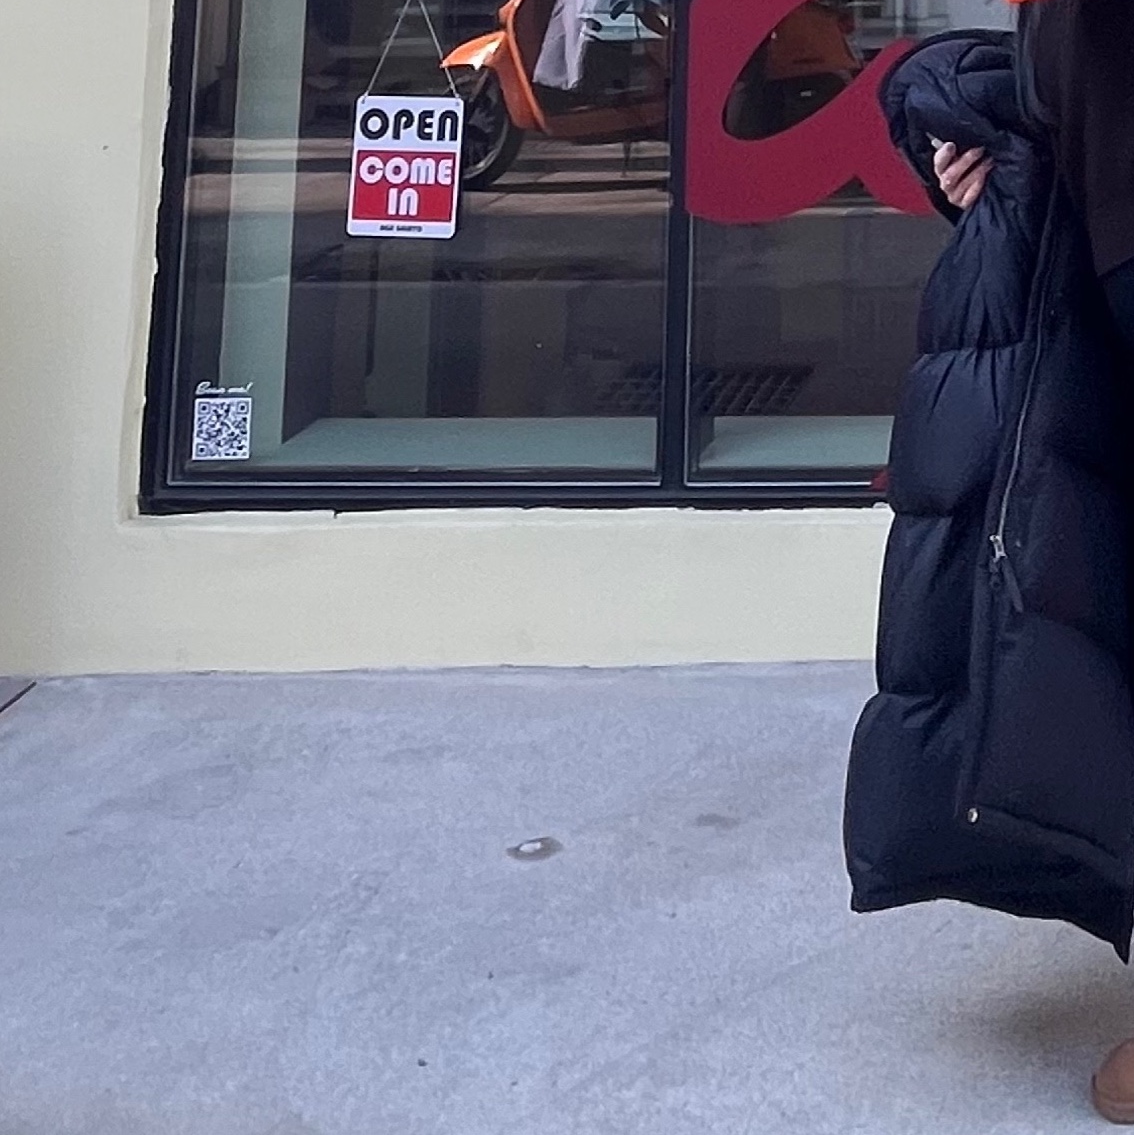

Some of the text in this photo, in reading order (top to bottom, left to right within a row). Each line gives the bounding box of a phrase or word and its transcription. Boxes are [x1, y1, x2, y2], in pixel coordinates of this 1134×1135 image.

[359, 107, 460, 142] OPEN
[359, 155, 454, 185] COME
[387, 187, 419, 216] IN
